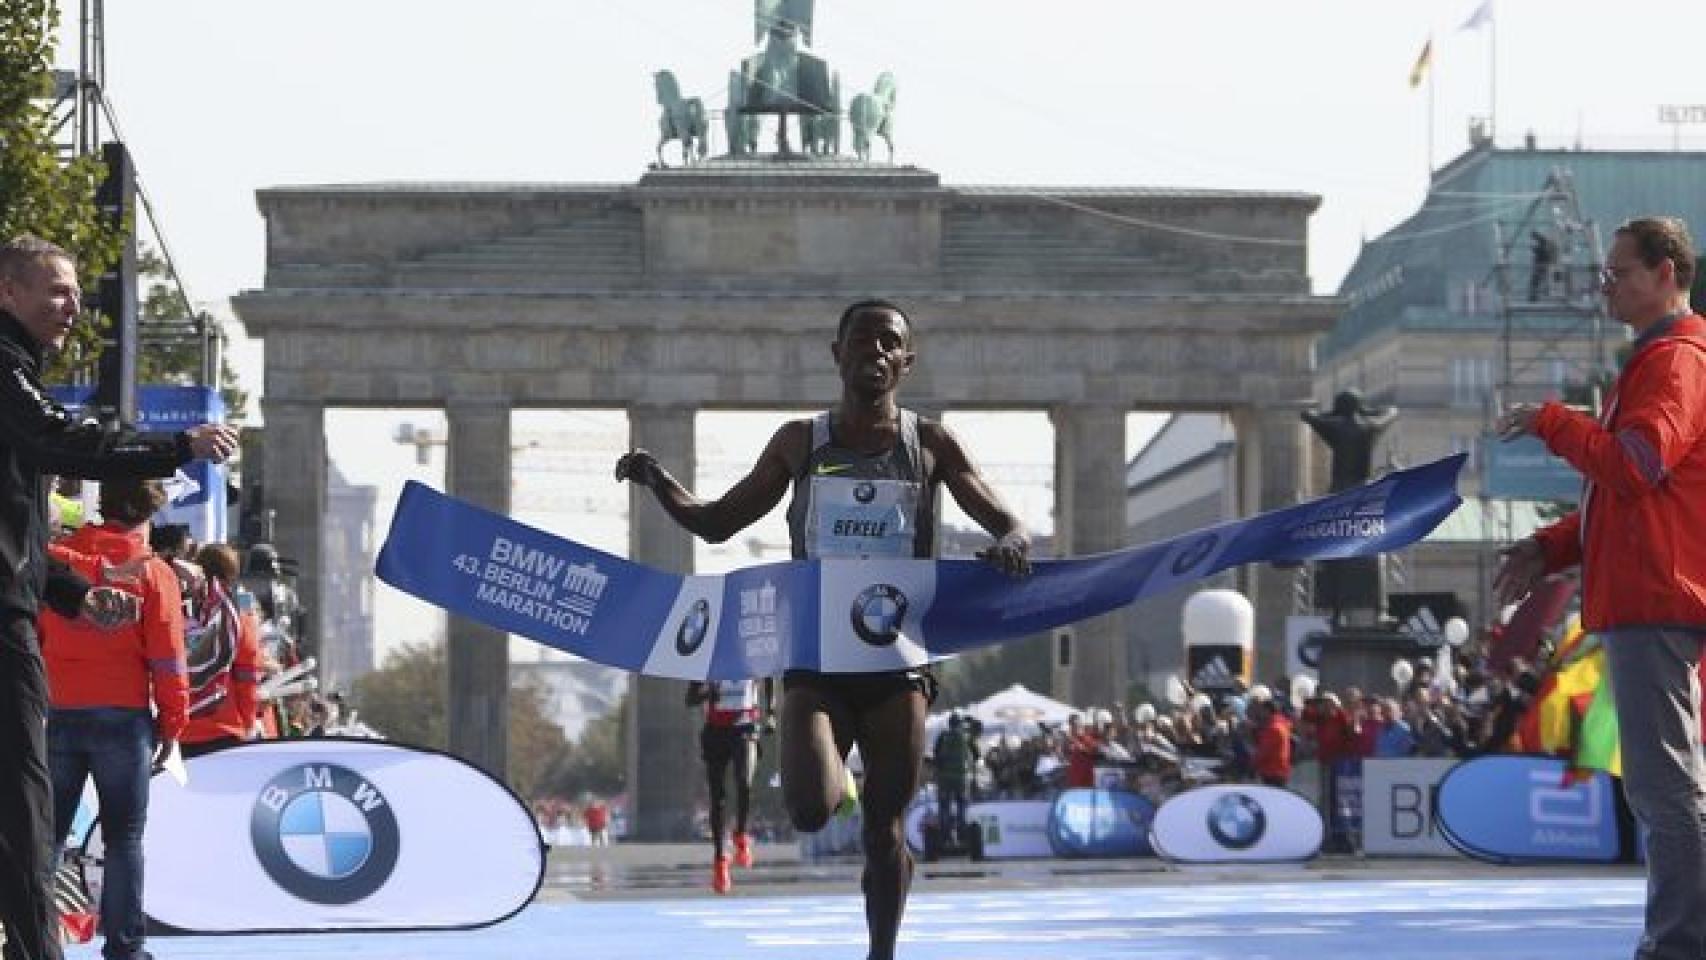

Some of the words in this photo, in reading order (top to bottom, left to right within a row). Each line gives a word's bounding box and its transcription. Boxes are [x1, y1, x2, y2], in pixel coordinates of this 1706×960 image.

[1657, 104, 1706, 122] HOT
[452, 554, 480, 577] 43.
[484, 562, 555, 601] BERLIN
[490, 538, 565, 579] BMW
[476, 583, 590, 635] MARATHON
[260, 767, 385, 811] BMW
[1391, 784, 1437, 838] B
